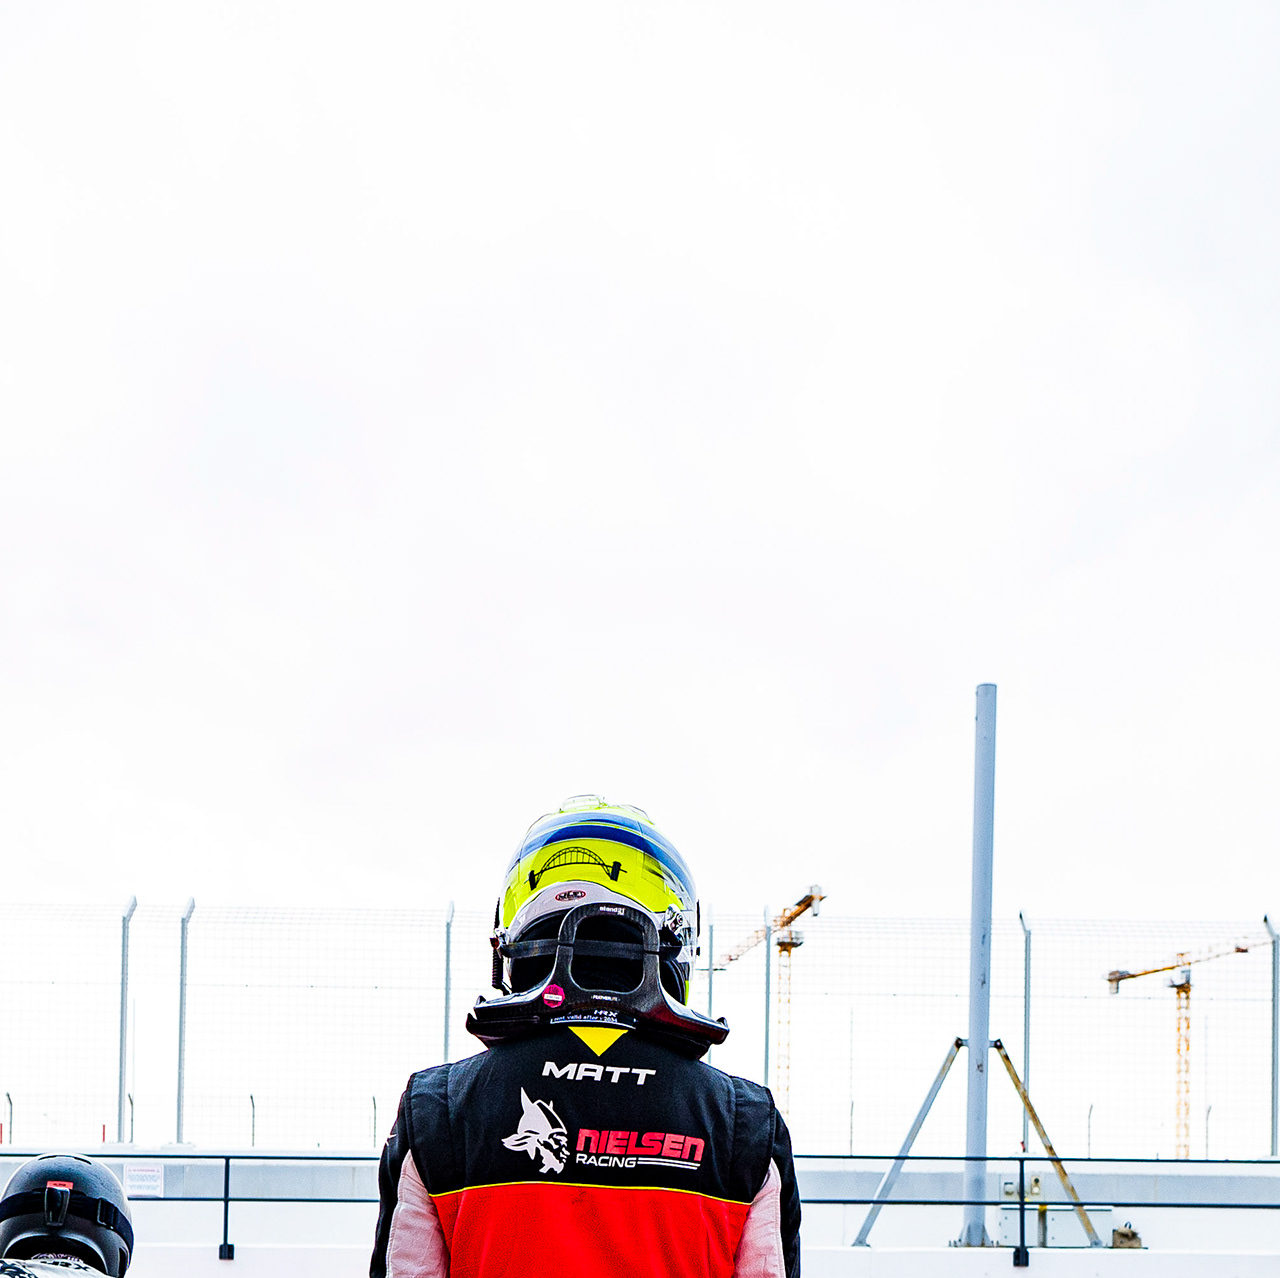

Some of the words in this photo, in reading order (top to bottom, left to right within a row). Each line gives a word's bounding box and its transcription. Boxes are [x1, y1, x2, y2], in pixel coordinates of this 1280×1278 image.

[542, 1061, 657, 1086] MATT
[576, 1128, 706, 1162] NIELSEN
[576, 1153, 637, 1168] RACING
